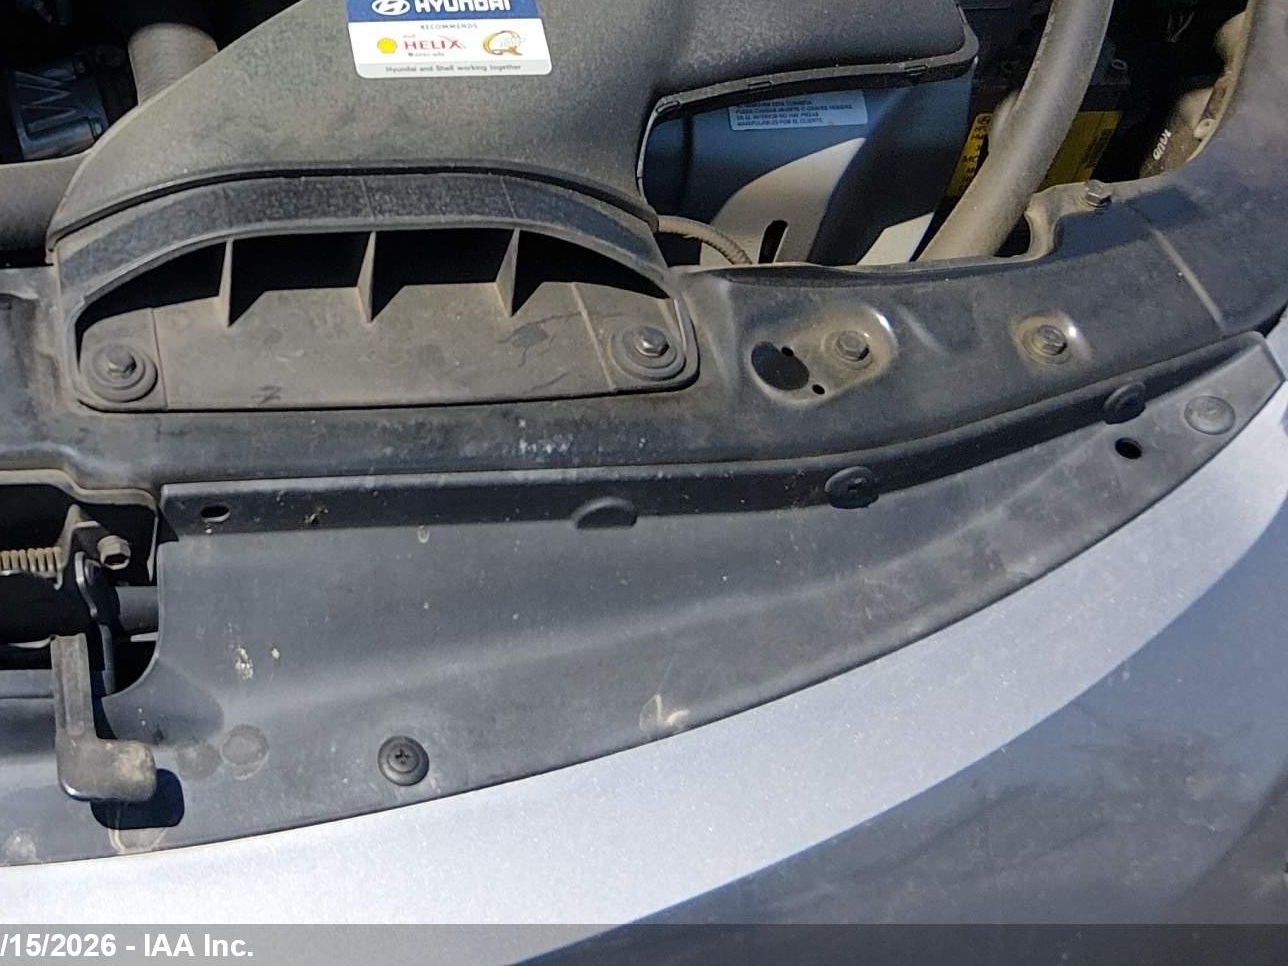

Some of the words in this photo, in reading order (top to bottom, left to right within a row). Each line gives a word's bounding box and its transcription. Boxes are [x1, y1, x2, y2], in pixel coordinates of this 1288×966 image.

[403, 39, 463, 50] HELIX
[385, 65, 417, 73] Hyundai
[489, 64, 521, 72] together
